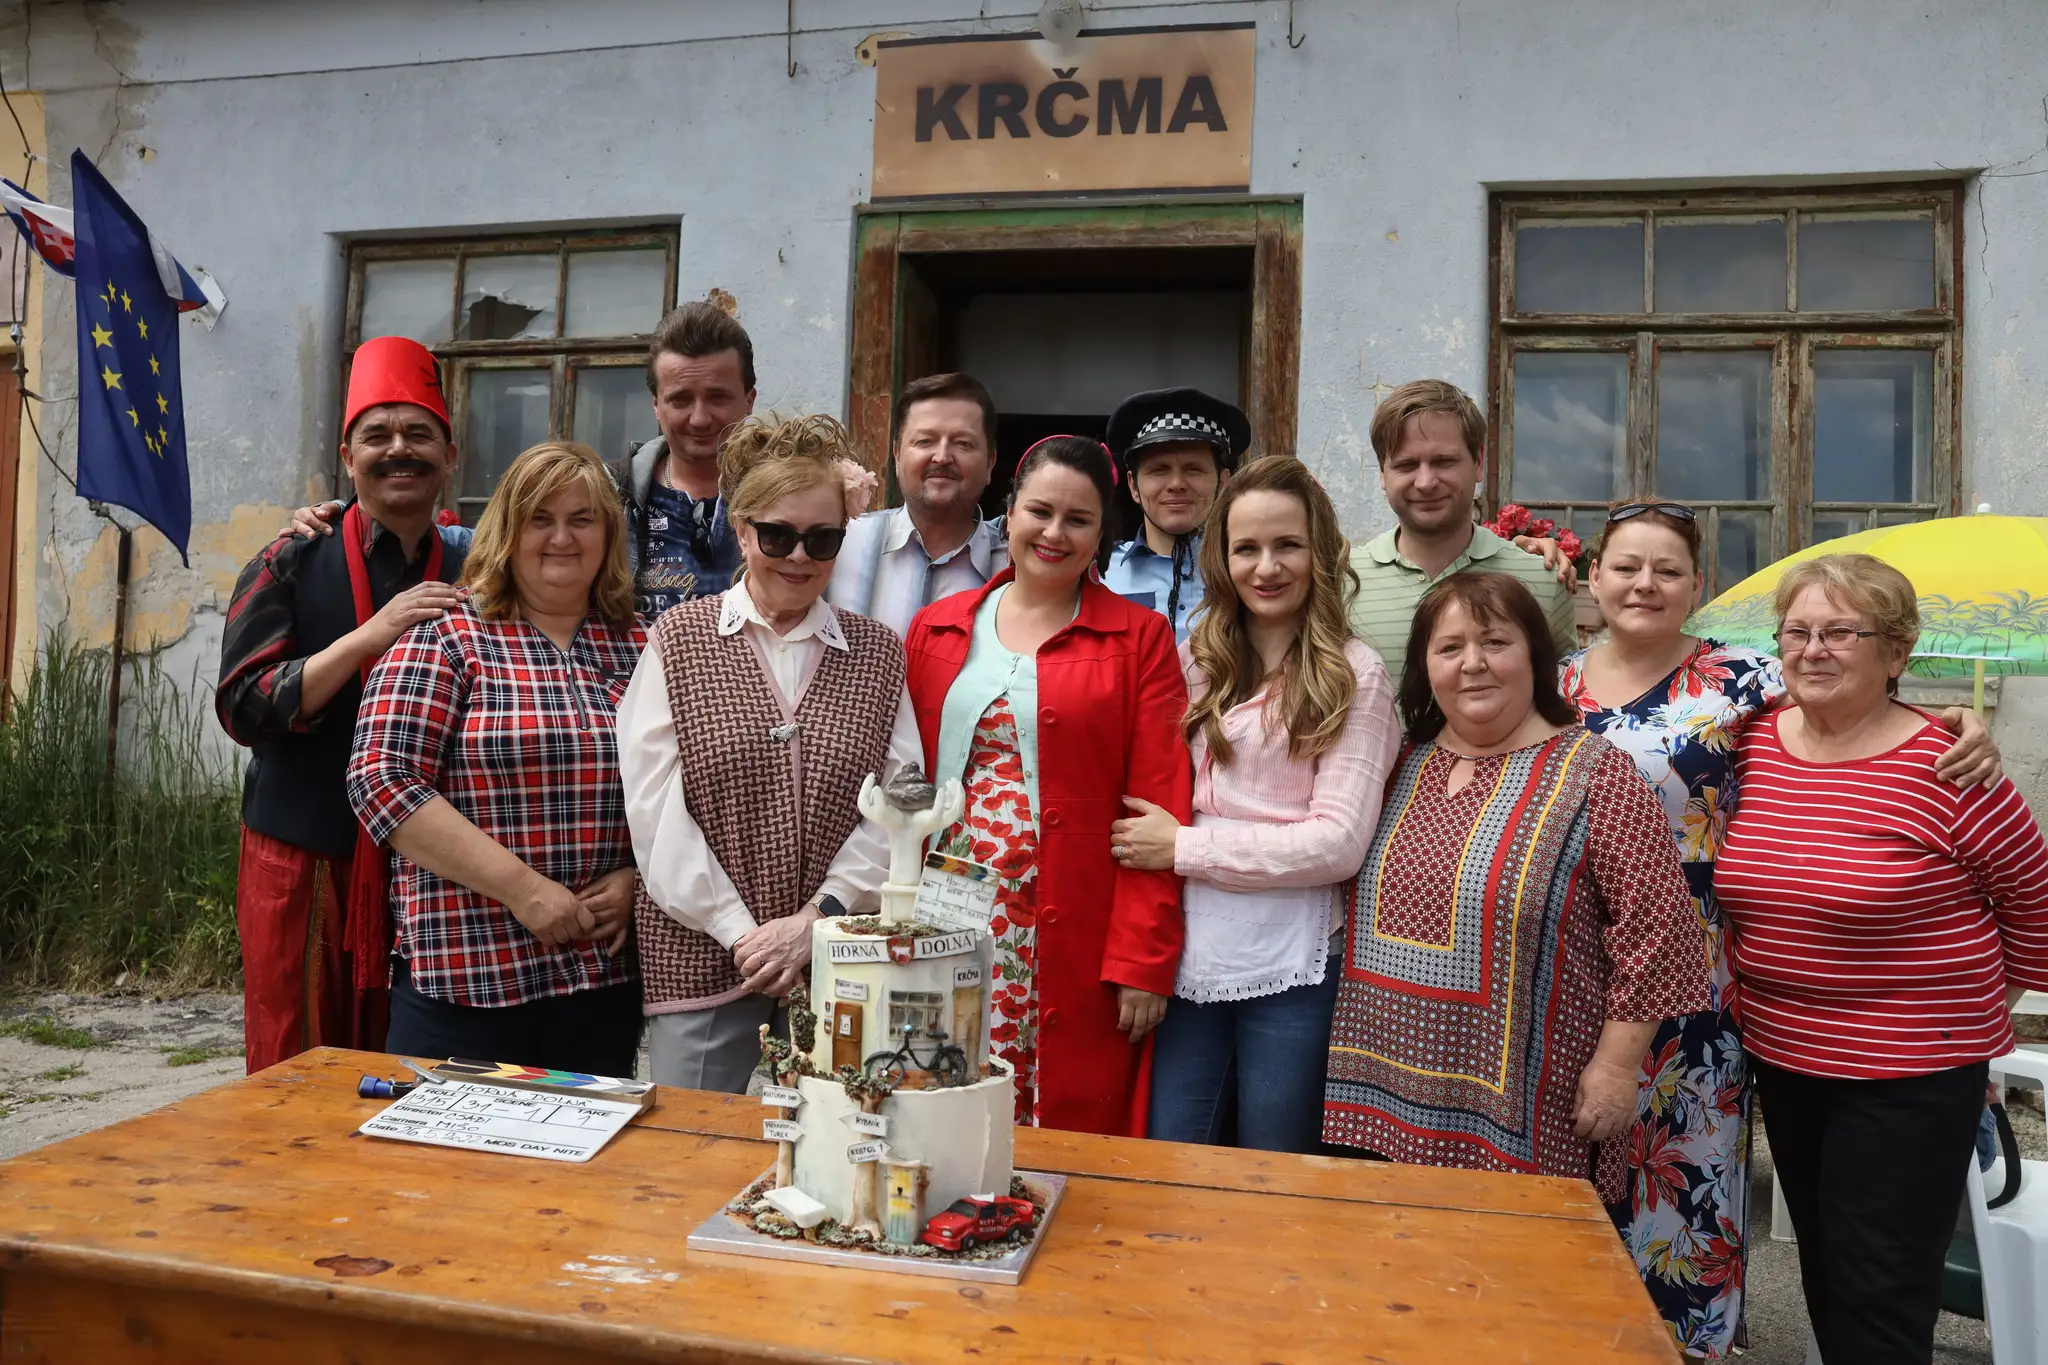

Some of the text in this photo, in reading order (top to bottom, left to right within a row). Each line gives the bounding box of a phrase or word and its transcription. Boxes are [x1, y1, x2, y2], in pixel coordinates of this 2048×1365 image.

[914, 67, 1228, 142] KRČMA
[831, 932, 972, 958] HORNÁ DOLNÁ
[424, 1088, 458, 1098] ROLL
[493, 1098, 537, 1108] SCENE
[394, 1104, 446, 1116] Director
[577, 1108, 611, 1117] TAKE
[380, 1115, 428, 1126] Camera
[367, 1123, 398, 1132] Date
[484, 1139, 585, 1157] MOS DAY NITE
